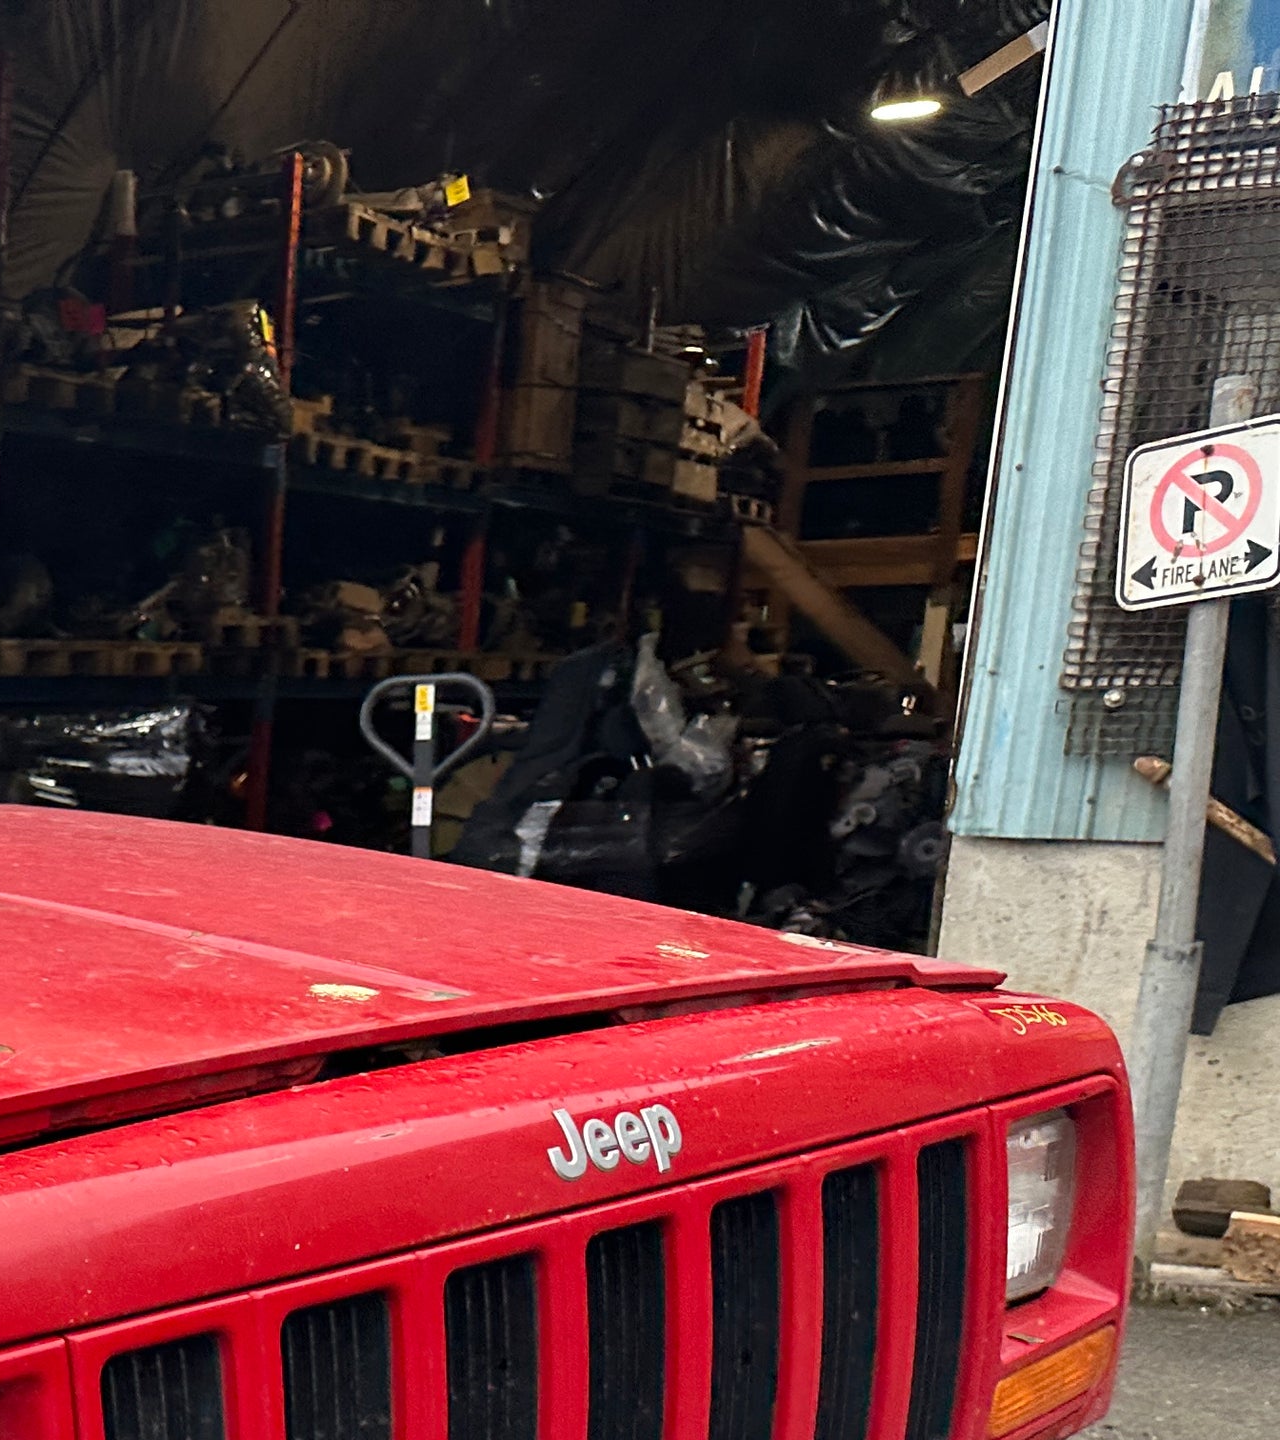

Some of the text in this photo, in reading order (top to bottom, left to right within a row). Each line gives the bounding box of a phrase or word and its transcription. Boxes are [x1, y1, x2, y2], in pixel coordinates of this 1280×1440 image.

[1182, 469, 1234, 534] P
[1161, 556, 1238, 588] FIRE LANE
[988, 1004, 1067, 1035] J2566
[546, 1103, 682, 1182] Jeep
